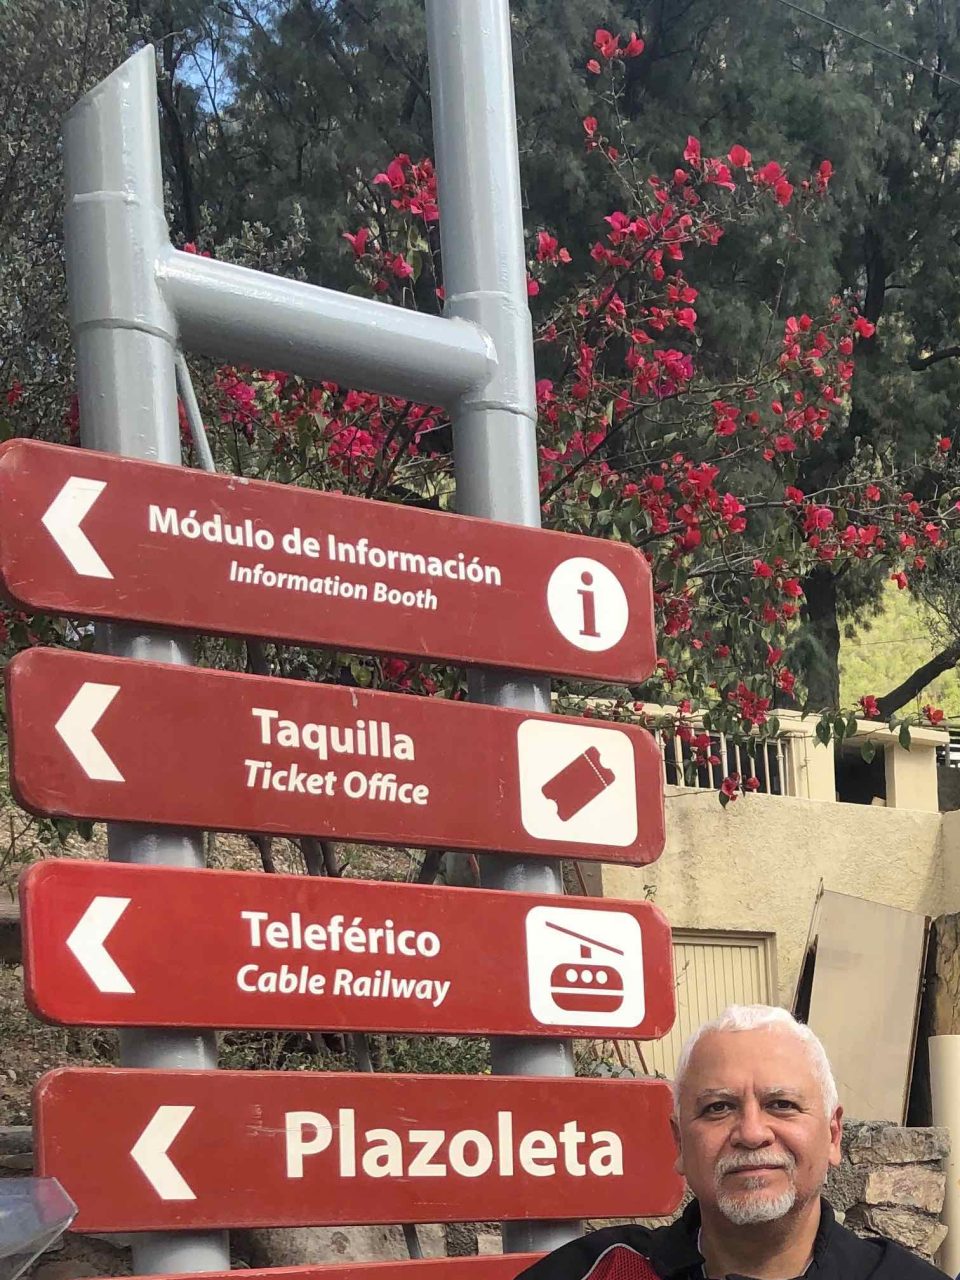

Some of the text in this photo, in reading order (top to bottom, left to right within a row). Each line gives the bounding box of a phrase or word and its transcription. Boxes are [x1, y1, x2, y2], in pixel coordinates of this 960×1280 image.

[148, 504, 502, 586] Módulo de Información
[229, 560, 438, 610] Information Booth
[252, 707, 415, 762] Taquilla
[244, 758, 430, 806] Ticket Office
[241, 910, 441, 958] Teleférico
[236, 964, 451, 1008] Cable Railway
[284, 1108, 624, 1178] Plazoleta
